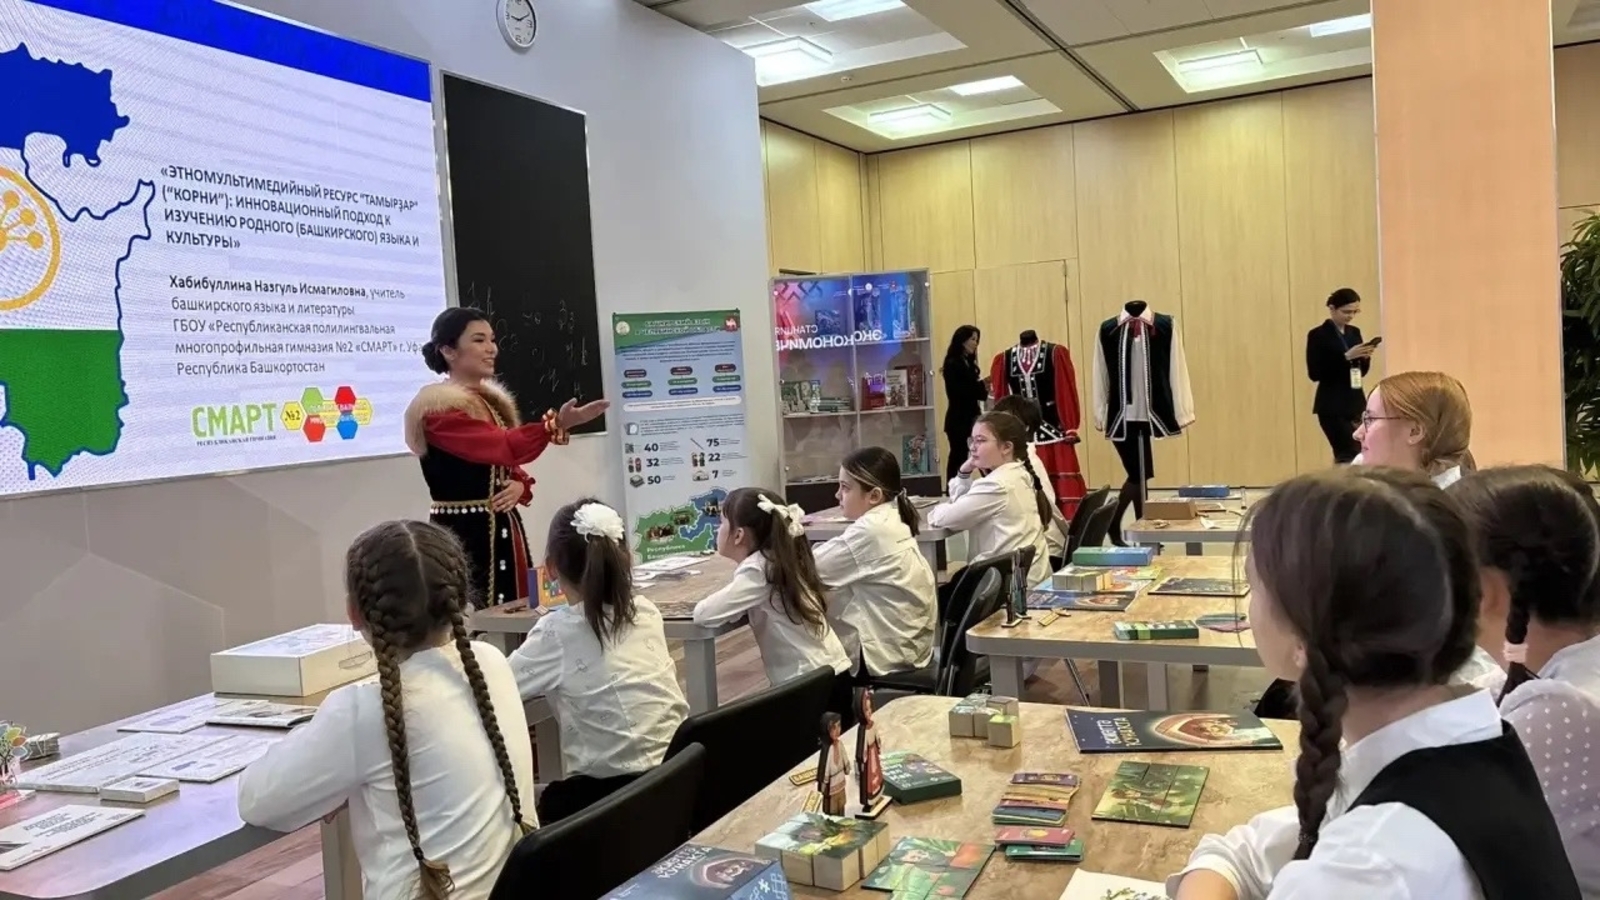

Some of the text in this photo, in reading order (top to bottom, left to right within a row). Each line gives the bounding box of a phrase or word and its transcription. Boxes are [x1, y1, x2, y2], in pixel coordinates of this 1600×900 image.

[160, 165, 321, 198] «ЭТНОМУЛЬТИМЕДИЙНЫЙ
[323, 188, 358, 204] РЕСУРС
[235, 193, 342, 220] ИННОВАЦИОННЫЙ
[342, 210, 384, 228] ПОДХОД
[384, 214, 391, 226] К
[164, 208, 420, 247] ИЗУЧЕНИЮ РОДНОГО (БАШКИРСКОГО) ЯЗЫКА И
[166, 230, 240, 250] КУЛЬТУРЫ»
[169, 274, 406, 301] Хабибуллина Назгуль Исмагиловна, учитель
[171, 296, 355, 318] башкирского языка и литературы
[174, 318, 396, 336] ГБОУ «Республиканская полилингвальная
[175, 340, 284, 357] многопрофильная
[285, 342, 334, 353] гимназия
[336, 341, 353, 353] №2
[355, 341, 398, 353] «СМАРТ»
[176, 360, 325, 377] Республика Башкортостан
[191, 402, 276, 438] СМАРТ
[284, 409, 300, 422] №2
[644, 442, 659, 452] 40
[706, 438, 720, 448] 75
[646, 458, 660, 467] 32
[708, 453, 721, 462] 22
[648, 475, 661, 484] 50
[712, 470, 718, 479] 7
